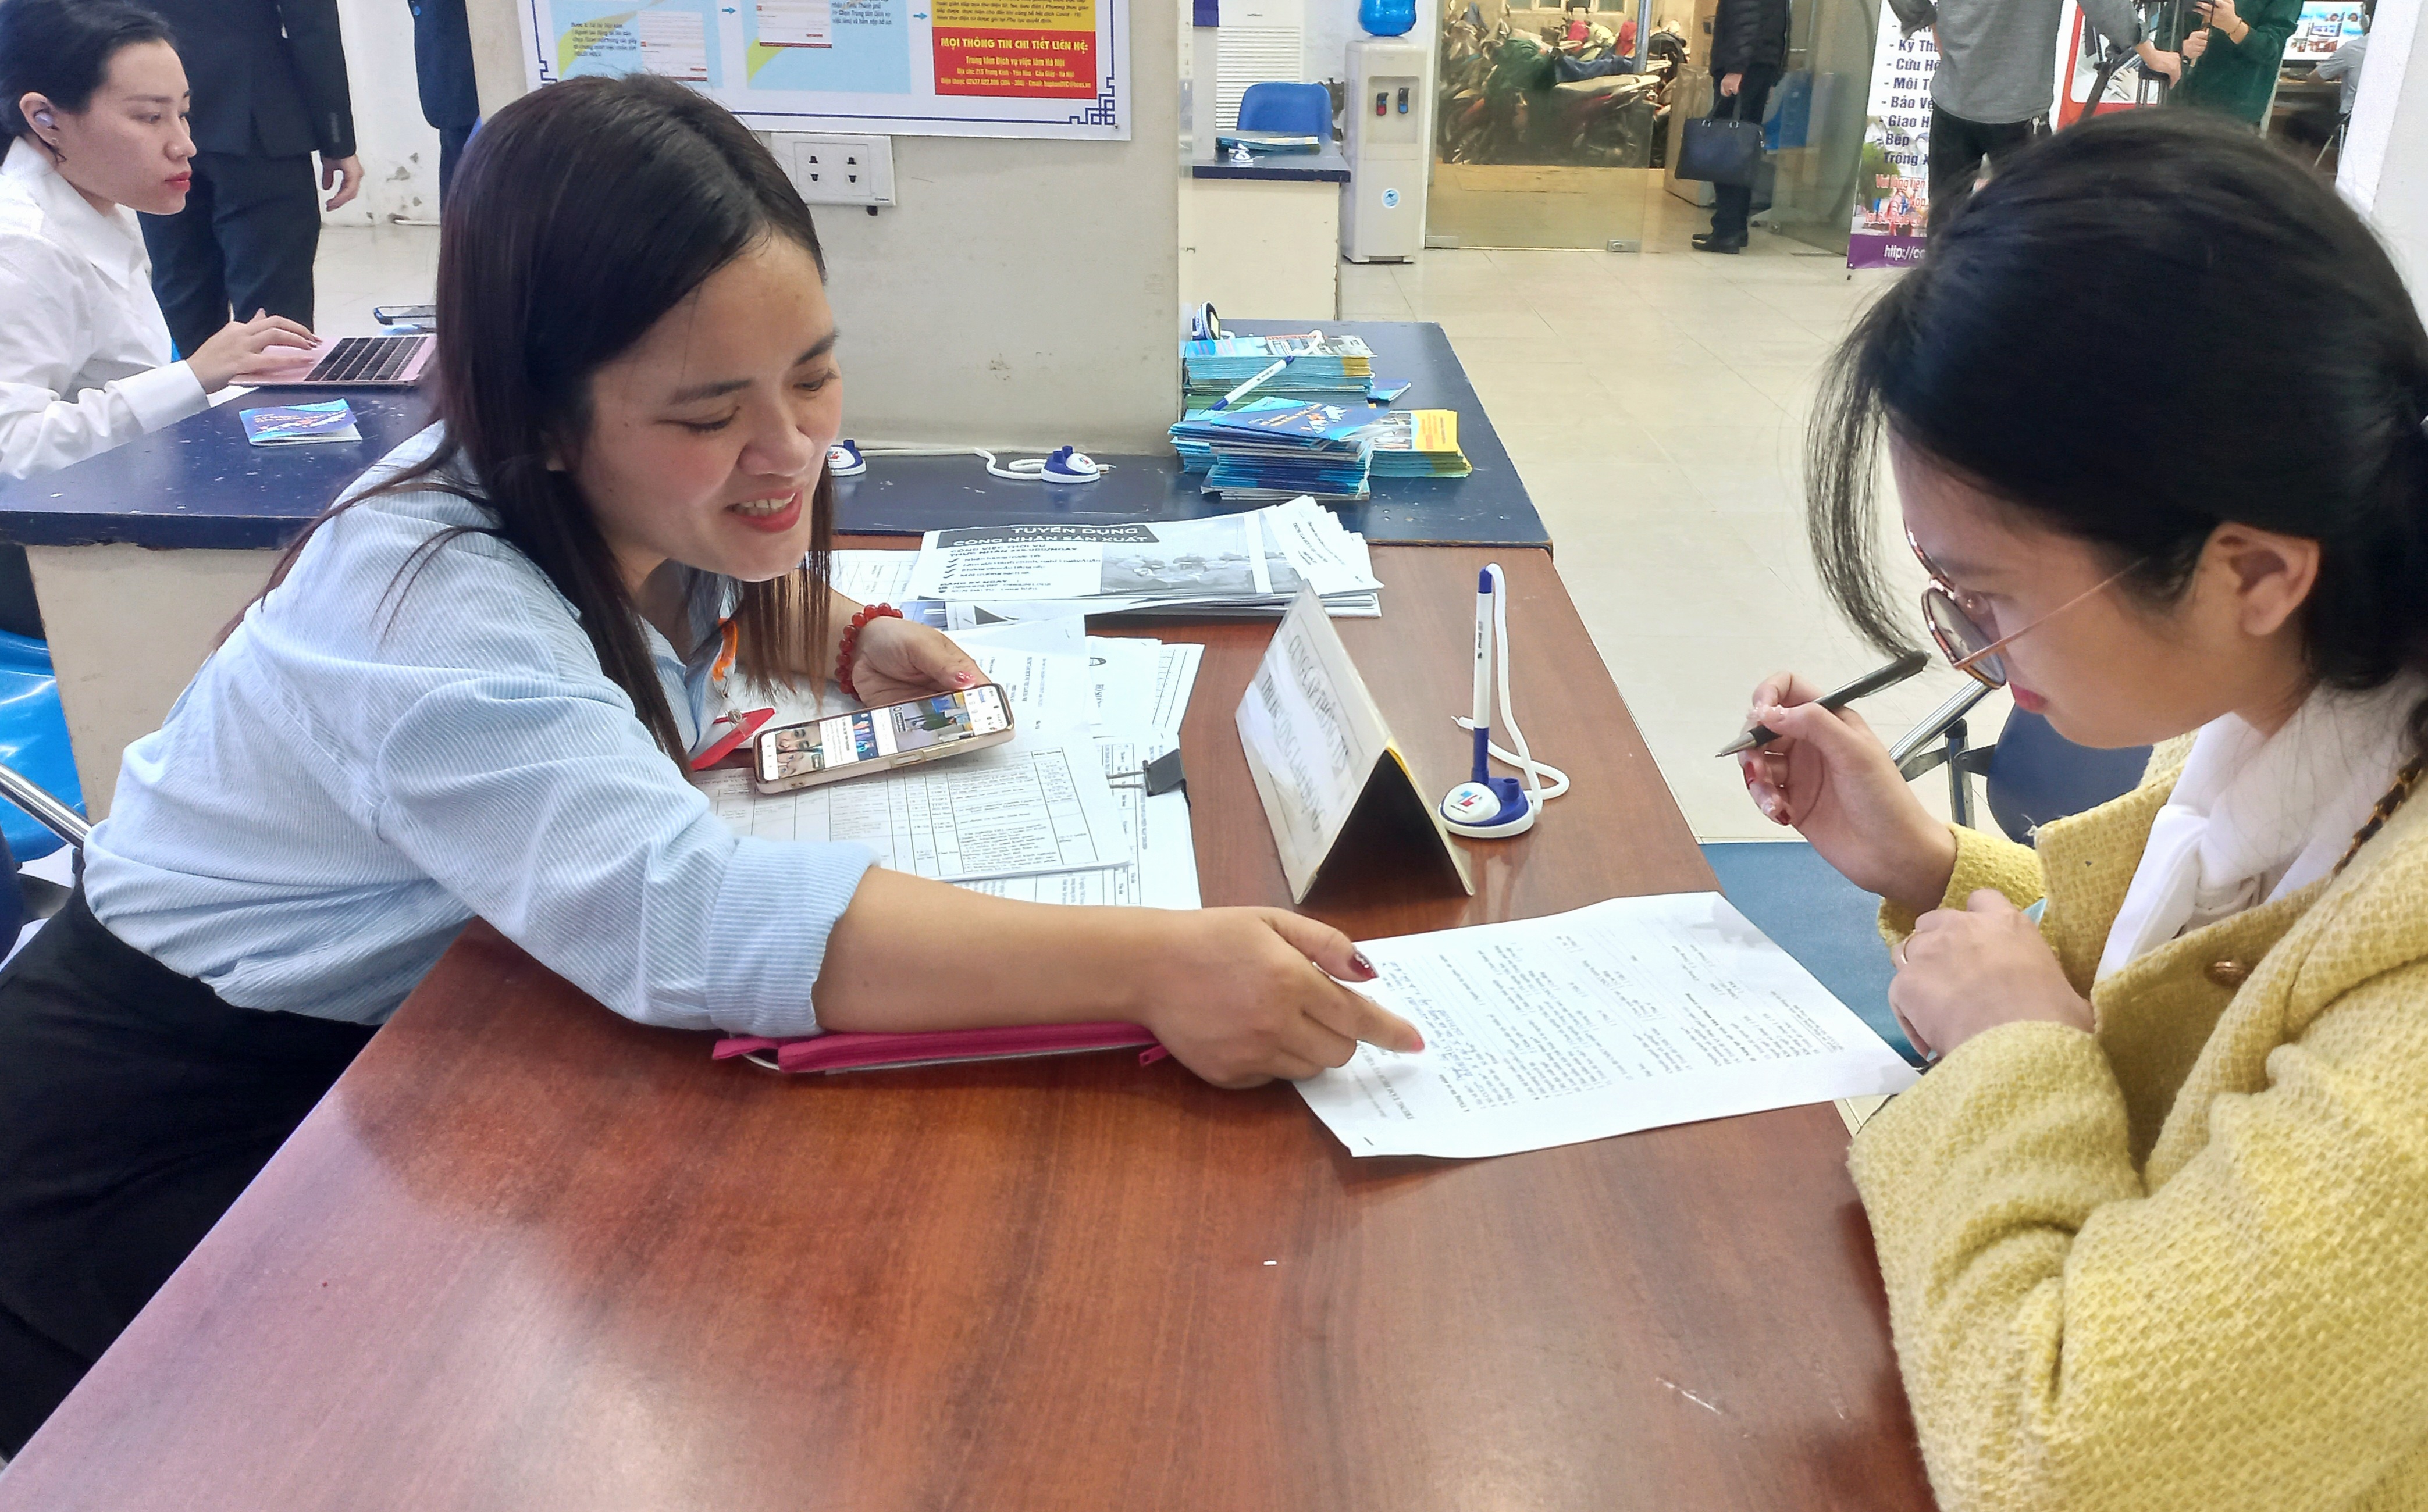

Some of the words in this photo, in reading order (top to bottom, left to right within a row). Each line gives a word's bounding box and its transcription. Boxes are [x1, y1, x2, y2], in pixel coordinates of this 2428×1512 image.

[941, 37, 960, 51] MỌI
[962, 36, 995, 49] THÔNG
[998, 38, 1013, 49] TIN
[1014, 40, 1029, 49] CHI
[1033, 35, 1049, 49] TIẾT
[1052, 39, 1071, 51] LIÊN
[1073, 40, 1088, 54] HỆ:
[1899, 38, 1914, 52] Kỹ
[966, 56, 982, 65] Trung
[1896, 58, 1920, 71] Cứu
[1893, 77, 1918, 90] Môi
[1891, 95, 1915, 108] Bảo
[1888, 115, 1917, 127] Giao
[1884, 152, 1918, 166] Trông
[1010, 526, 1076, 534] TUYỂN
[1082, 527, 1138, 536] DỤNG
[953, 538, 1003, 547] CÔNG
[1102, 534, 1148, 543] XUẤT
[1289, 634, 1309, 675] CUNG
[1313, 690, 1341, 747] THÔNG
[1331, 735, 1349, 772] TIN
[1290, 746, 1309, 787] LAO
[1300, 775, 1325, 833] ĐỘNG
